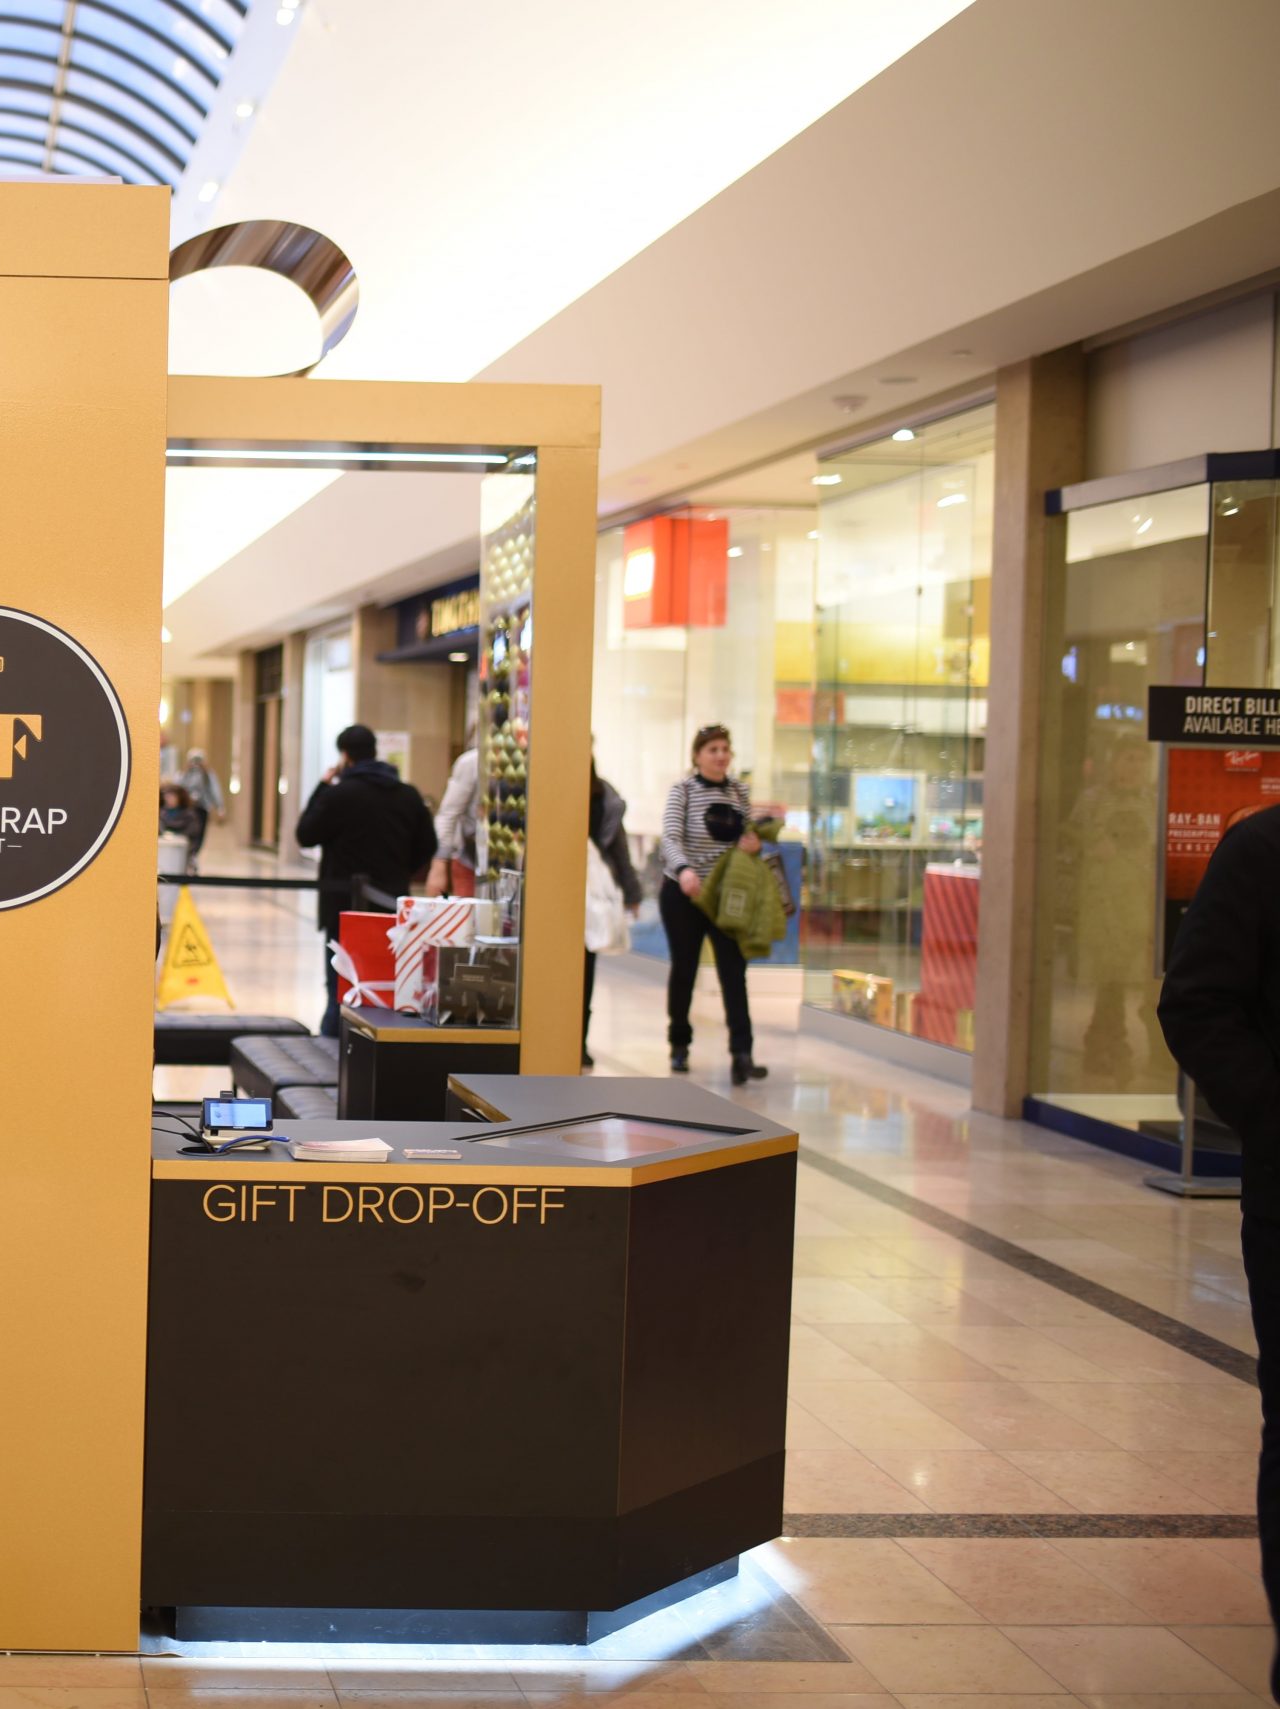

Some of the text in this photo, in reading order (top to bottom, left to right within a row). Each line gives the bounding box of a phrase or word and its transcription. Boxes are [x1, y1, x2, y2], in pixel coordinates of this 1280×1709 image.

[1185, 696, 1241, 715] DIRECT
[1183, 715, 1261, 735] AVAILABLE
[1168, 813, 1220, 825] RAY-BAN
[203, 1184, 565, 1225] GIFT DROP-OFF
